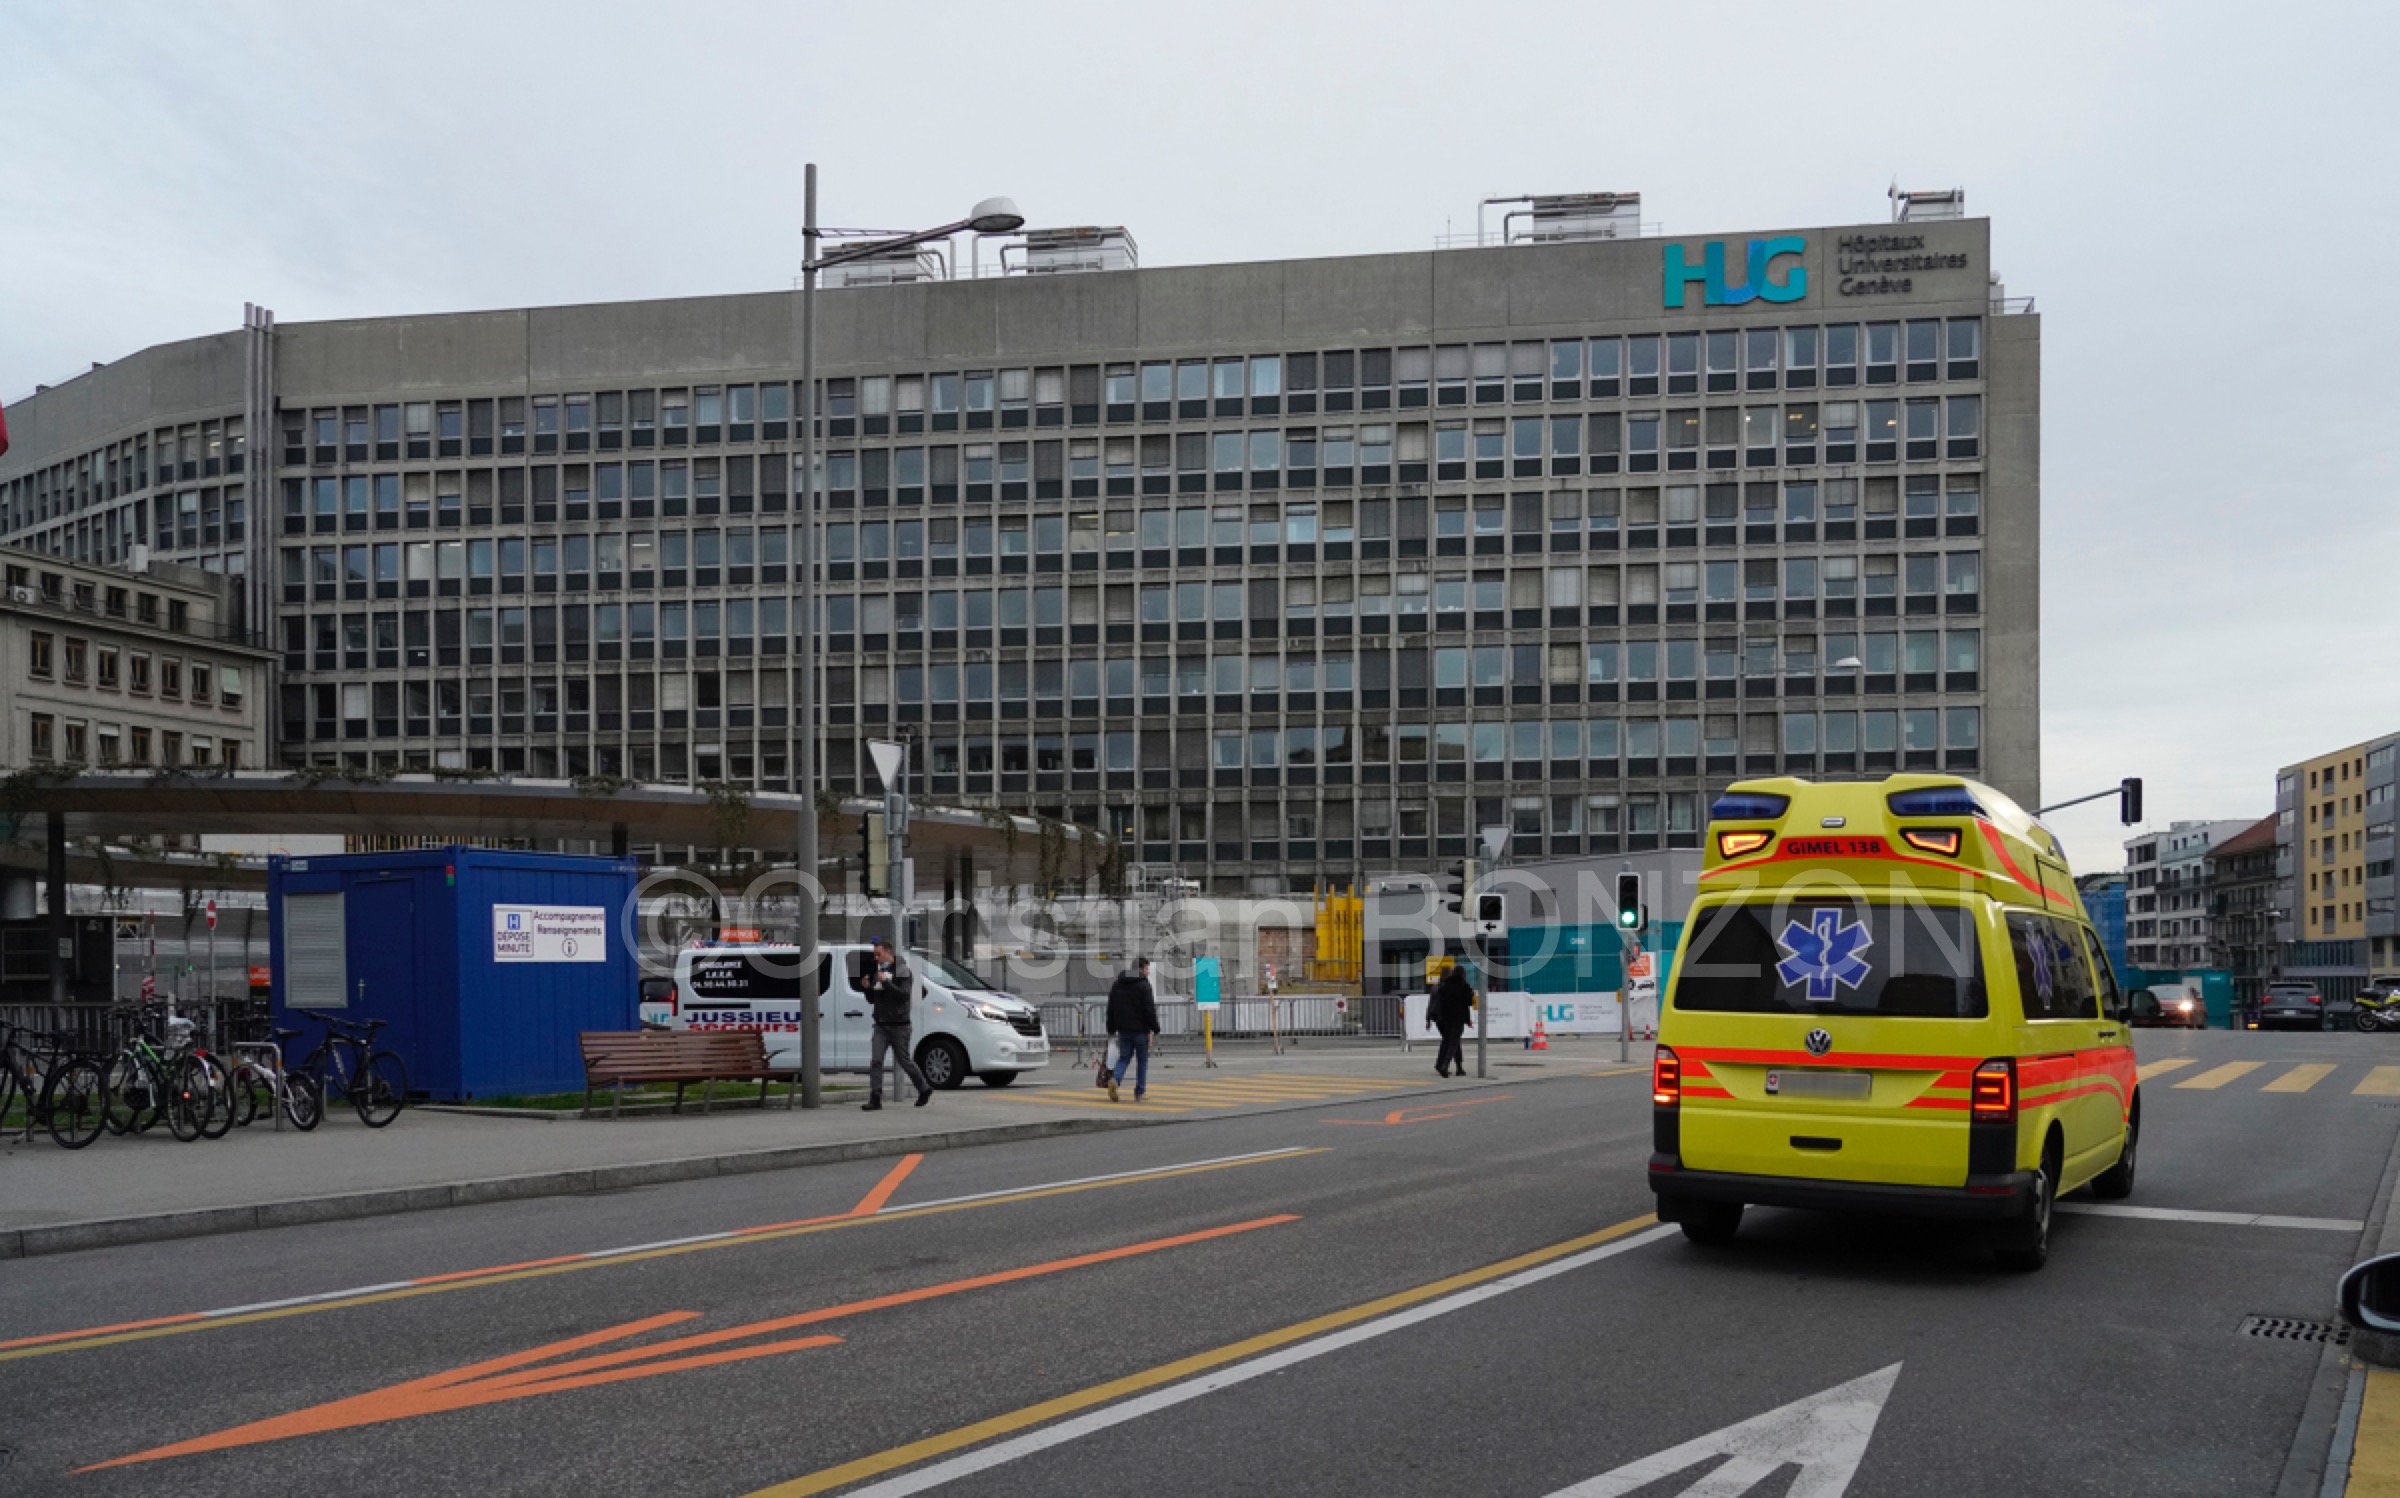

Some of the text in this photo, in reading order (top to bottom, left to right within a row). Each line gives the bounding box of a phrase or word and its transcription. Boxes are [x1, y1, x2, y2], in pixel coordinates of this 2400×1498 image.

[1838, 234, 1925, 256] Hôpitaux
[1664, 236, 1807, 308] HUG
[1838, 251, 1968, 275] Universitaires
[1839, 276, 1913, 297] Genève
[1787, 841, 1881, 855] GIMEL 138
[538, 924, 602, 937] Renseignements
[497, 943, 531, 953] MINUTE
[684, 1011, 802, 1023] JUSSIEU
[1535, 1003, 1575, 1022] HUG
